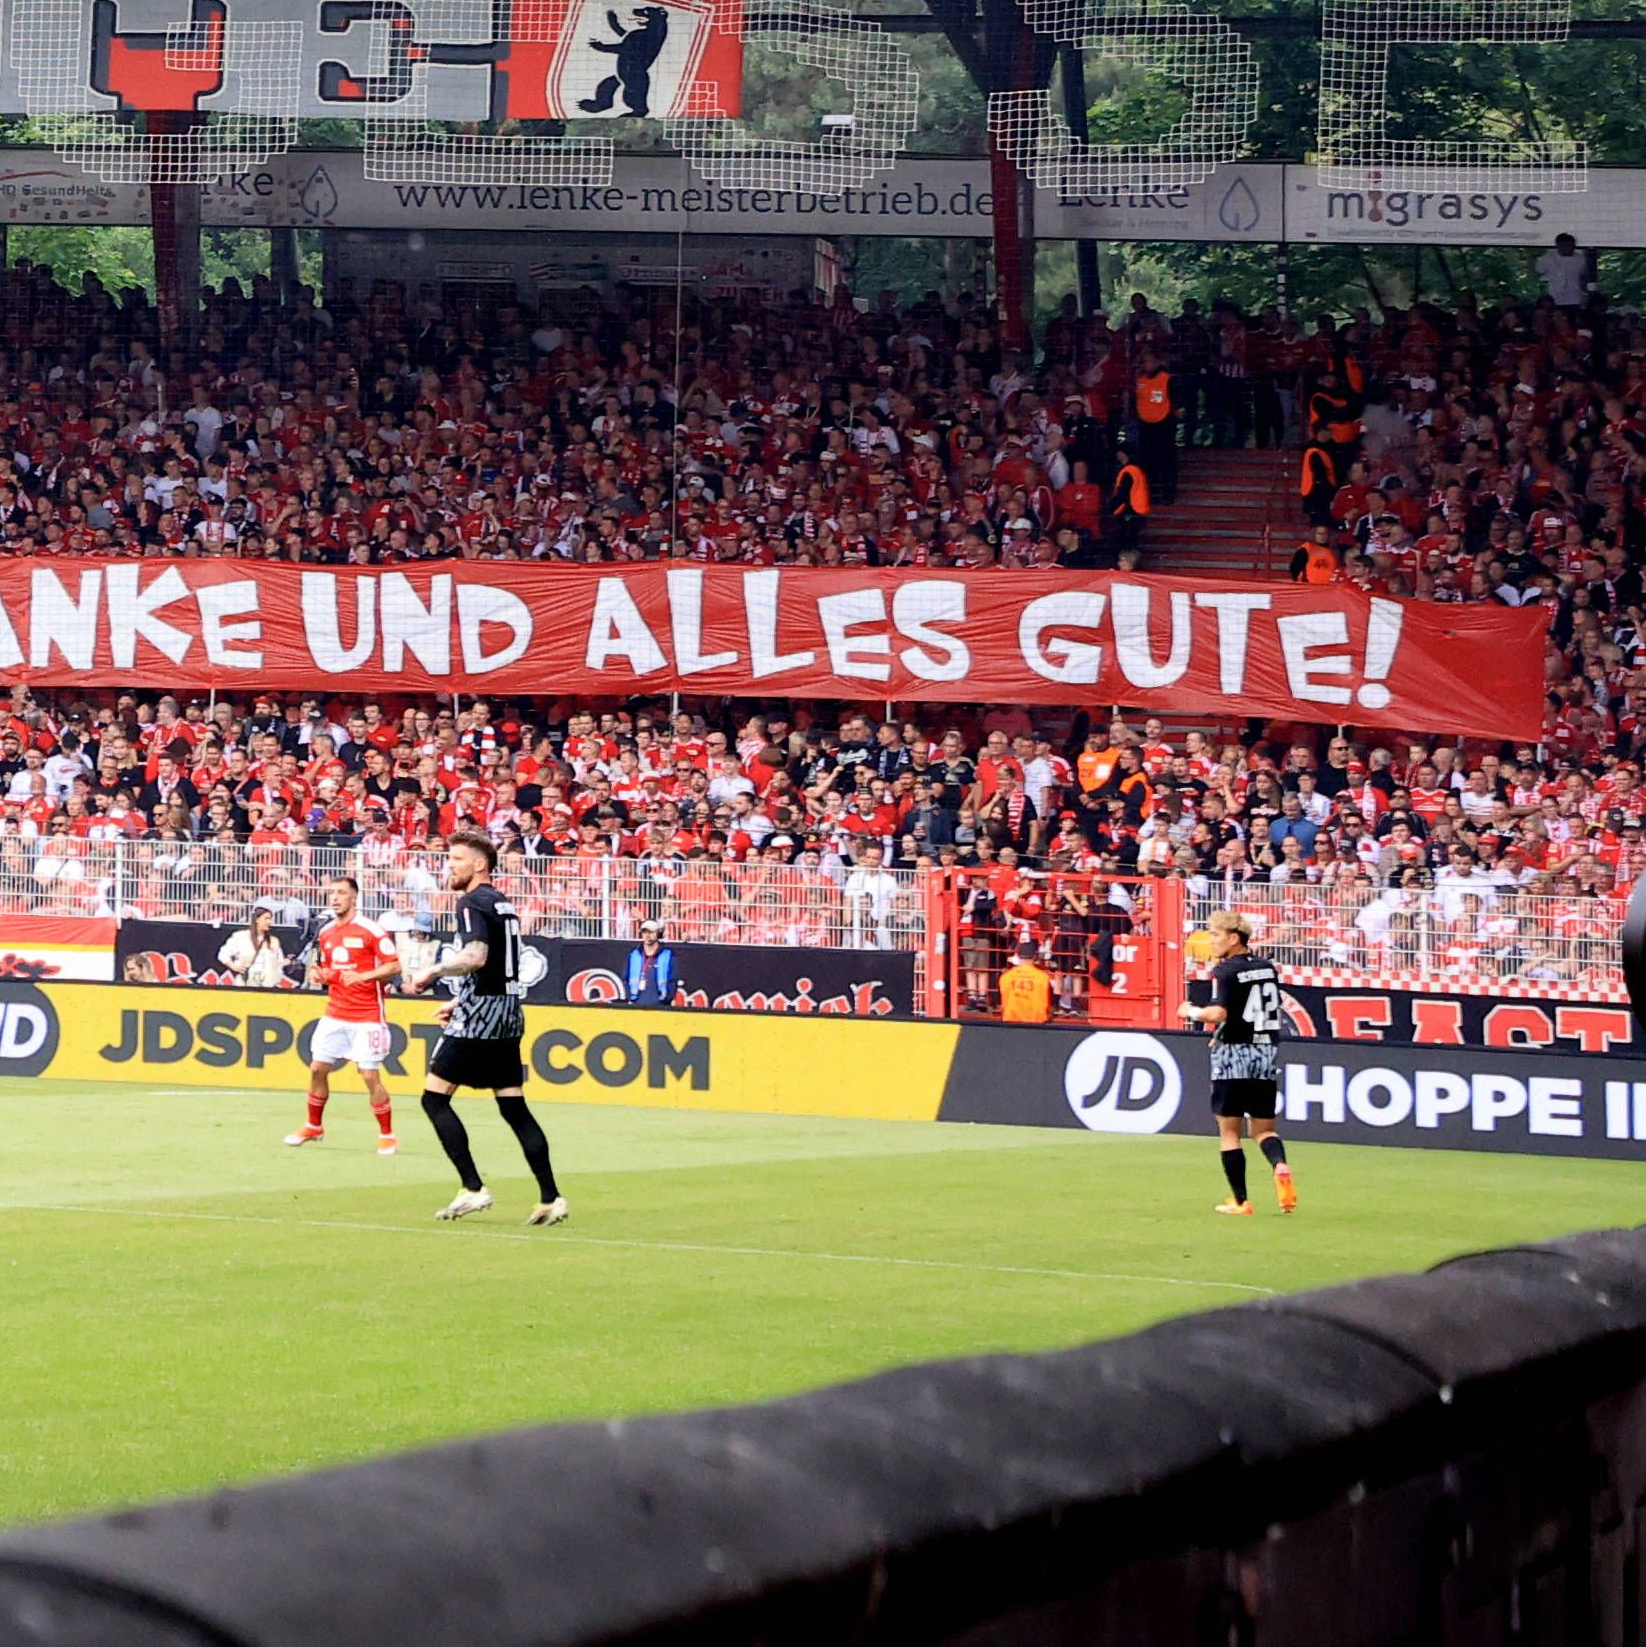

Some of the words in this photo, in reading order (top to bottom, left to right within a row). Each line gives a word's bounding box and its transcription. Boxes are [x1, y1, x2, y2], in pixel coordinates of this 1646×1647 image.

[393, 179, 995, 218] www.lenke-meisterbetrieb.de
[301, 570, 534, 675] UND
[586, 568, 971, 683] ALLES
[1018, 583, 1404, 709] GUTE!
[1110, 972, 1128, 995] 2
[1242, 982, 1281, 1033] 42
[1082, 1054, 1166, 1113] JD
[1276, 1063, 1585, 1138] HOPPE
